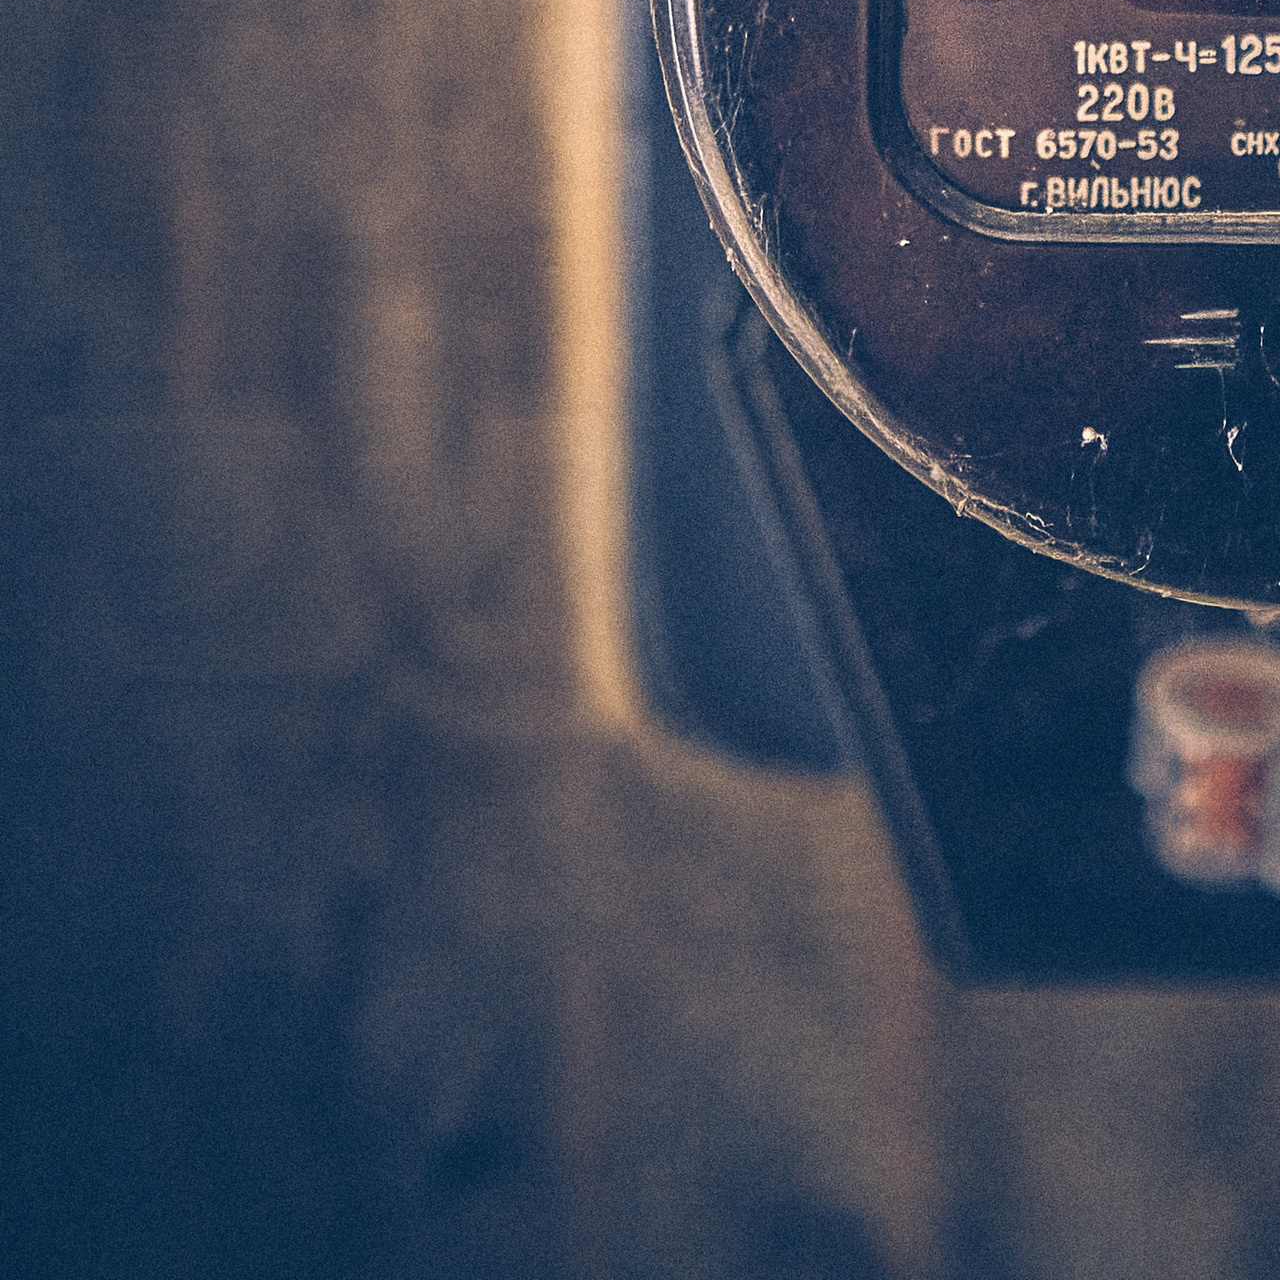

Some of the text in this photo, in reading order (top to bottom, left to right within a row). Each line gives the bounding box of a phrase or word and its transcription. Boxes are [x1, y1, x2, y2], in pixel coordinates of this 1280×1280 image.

[1077, 83, 1176, 122] 220В
[929, 128, 1179, 160] ГОСТ 6570-53
[1231, 132, 1280, 156] СНХ
